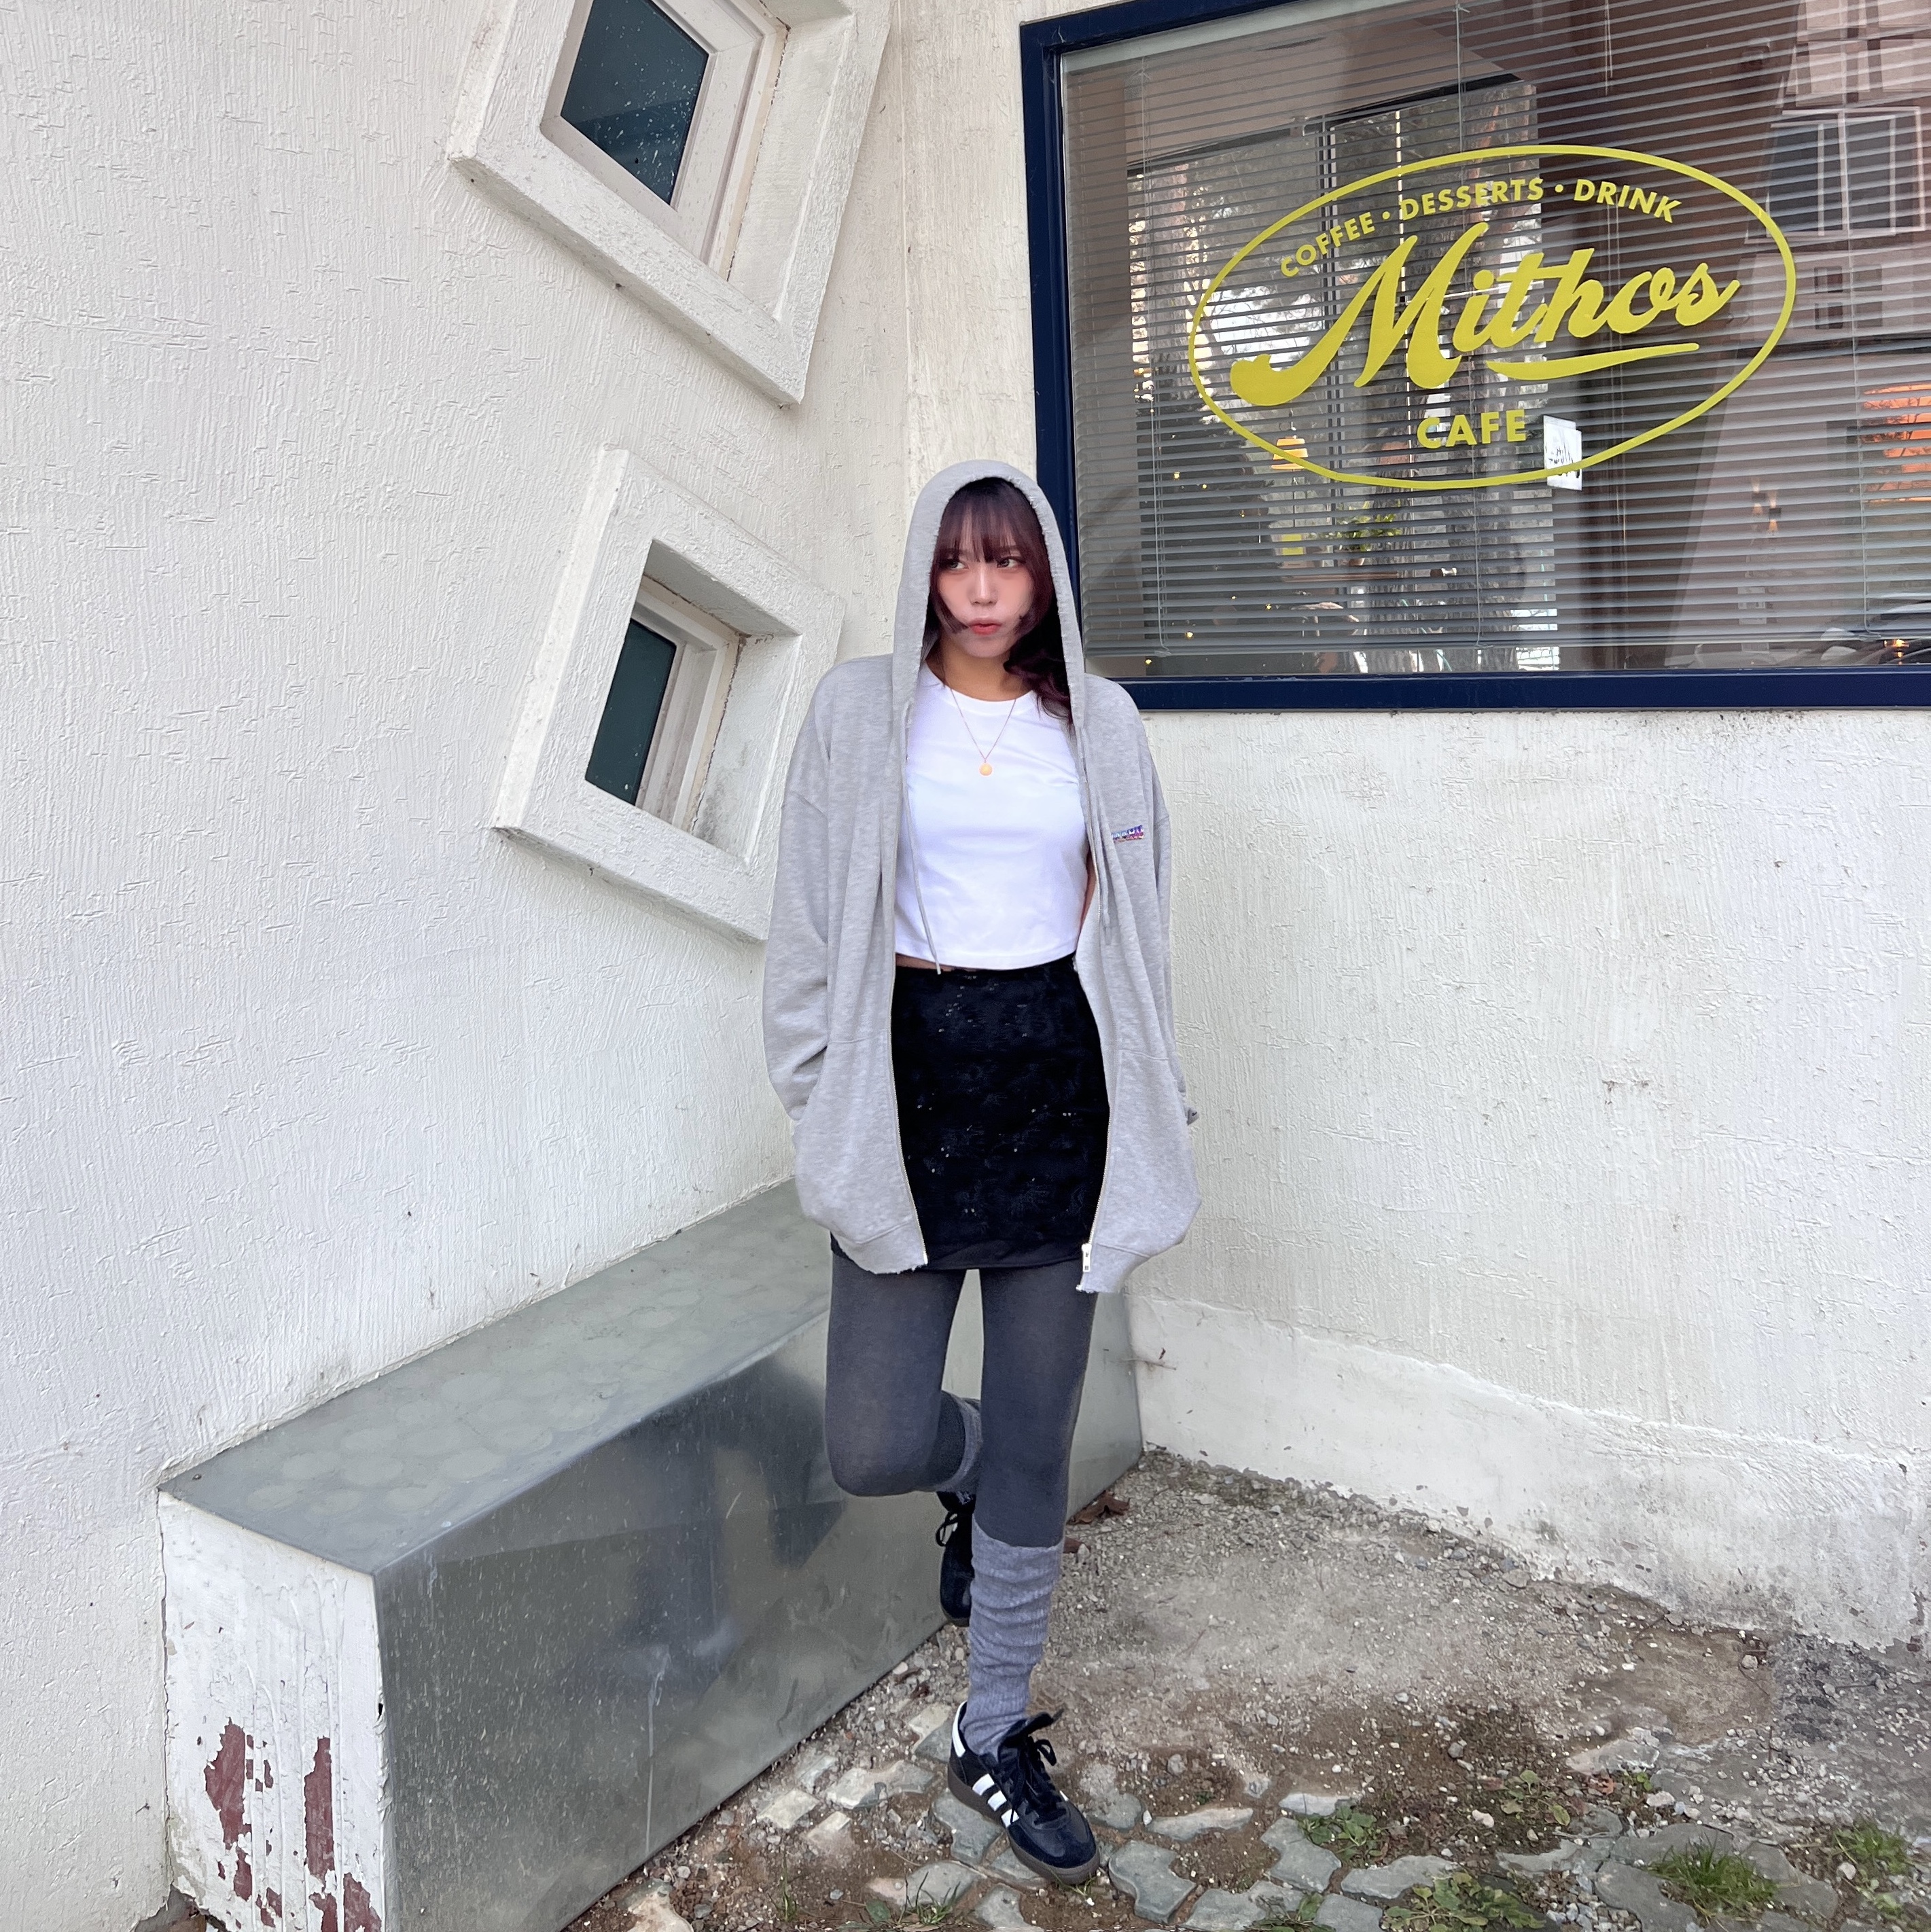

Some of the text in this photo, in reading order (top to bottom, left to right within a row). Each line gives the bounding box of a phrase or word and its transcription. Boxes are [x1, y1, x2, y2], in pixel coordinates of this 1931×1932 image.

[1281, 178, 1682, 278] COFFEE DESSERTS DRINK
[1229, 221, 1741, 407] Mithos
[1415, 409, 1527, 450] CAFE
